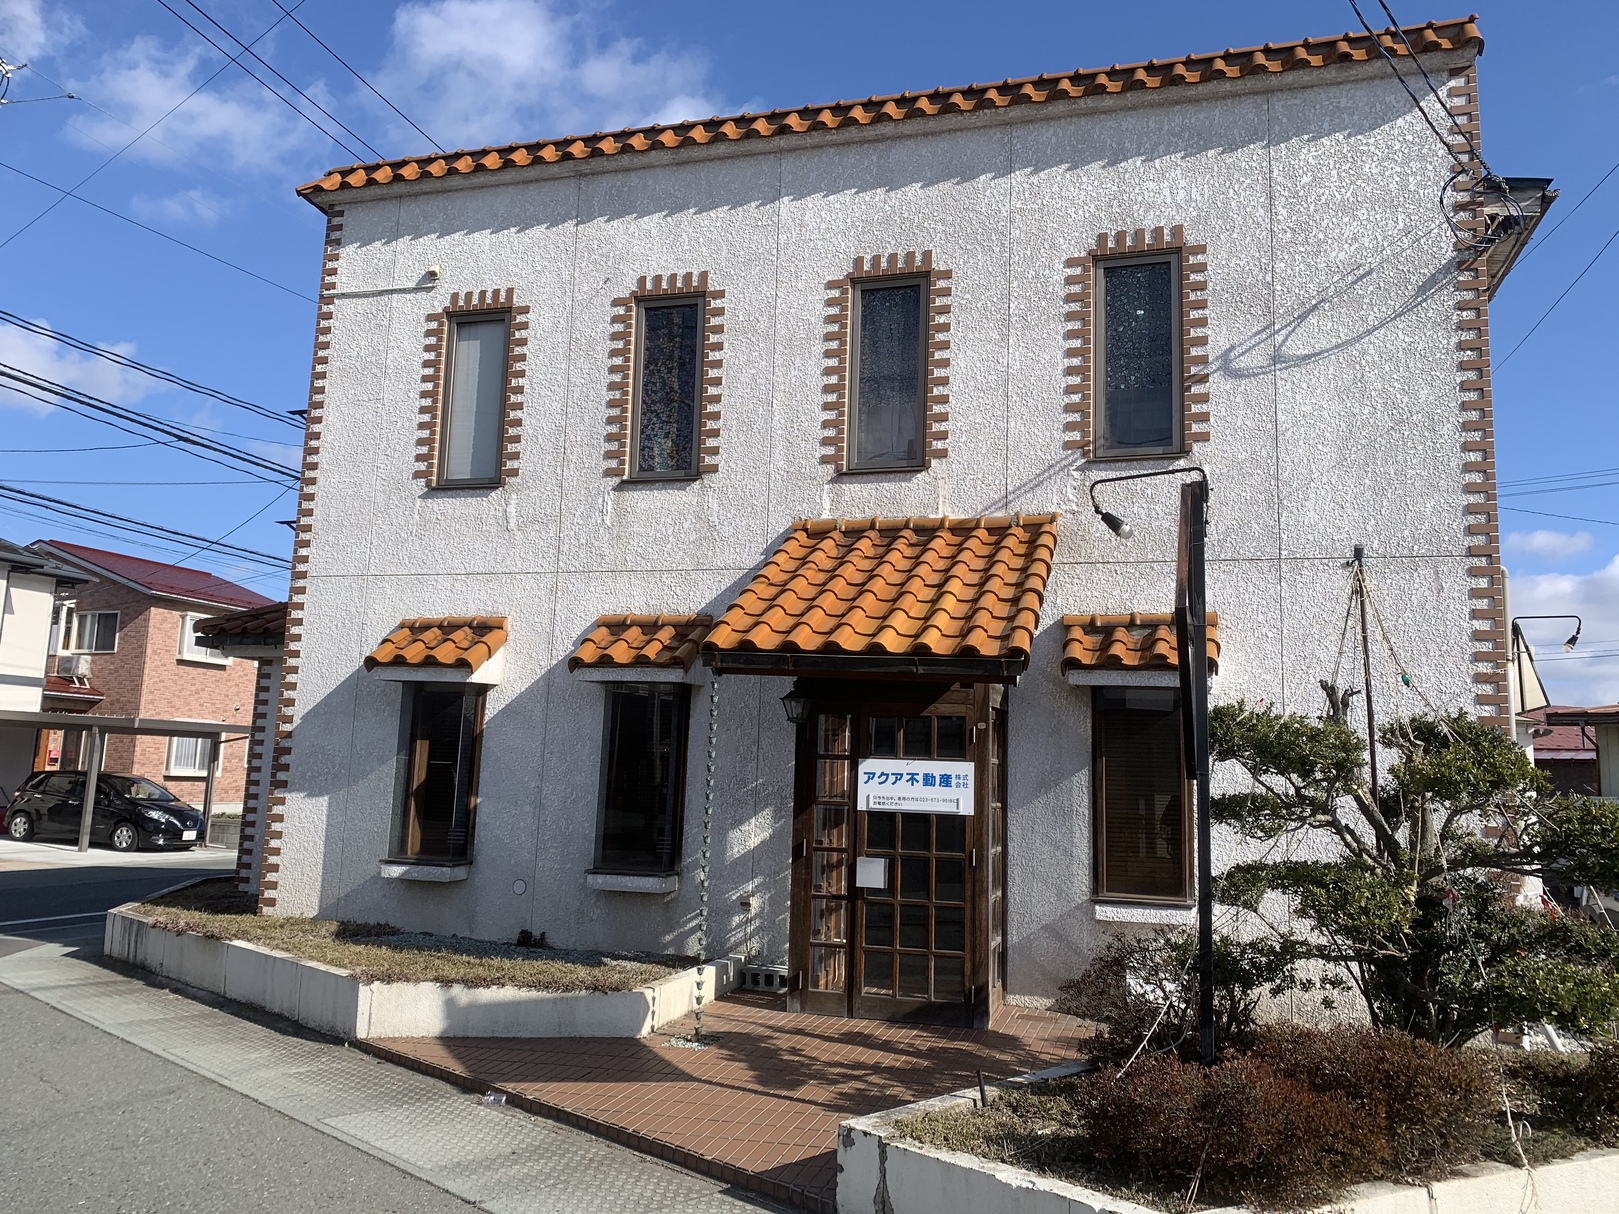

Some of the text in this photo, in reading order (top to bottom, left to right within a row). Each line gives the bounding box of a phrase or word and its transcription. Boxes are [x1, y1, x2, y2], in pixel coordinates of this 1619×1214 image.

[863, 771, 953, 788] アクア不動産
